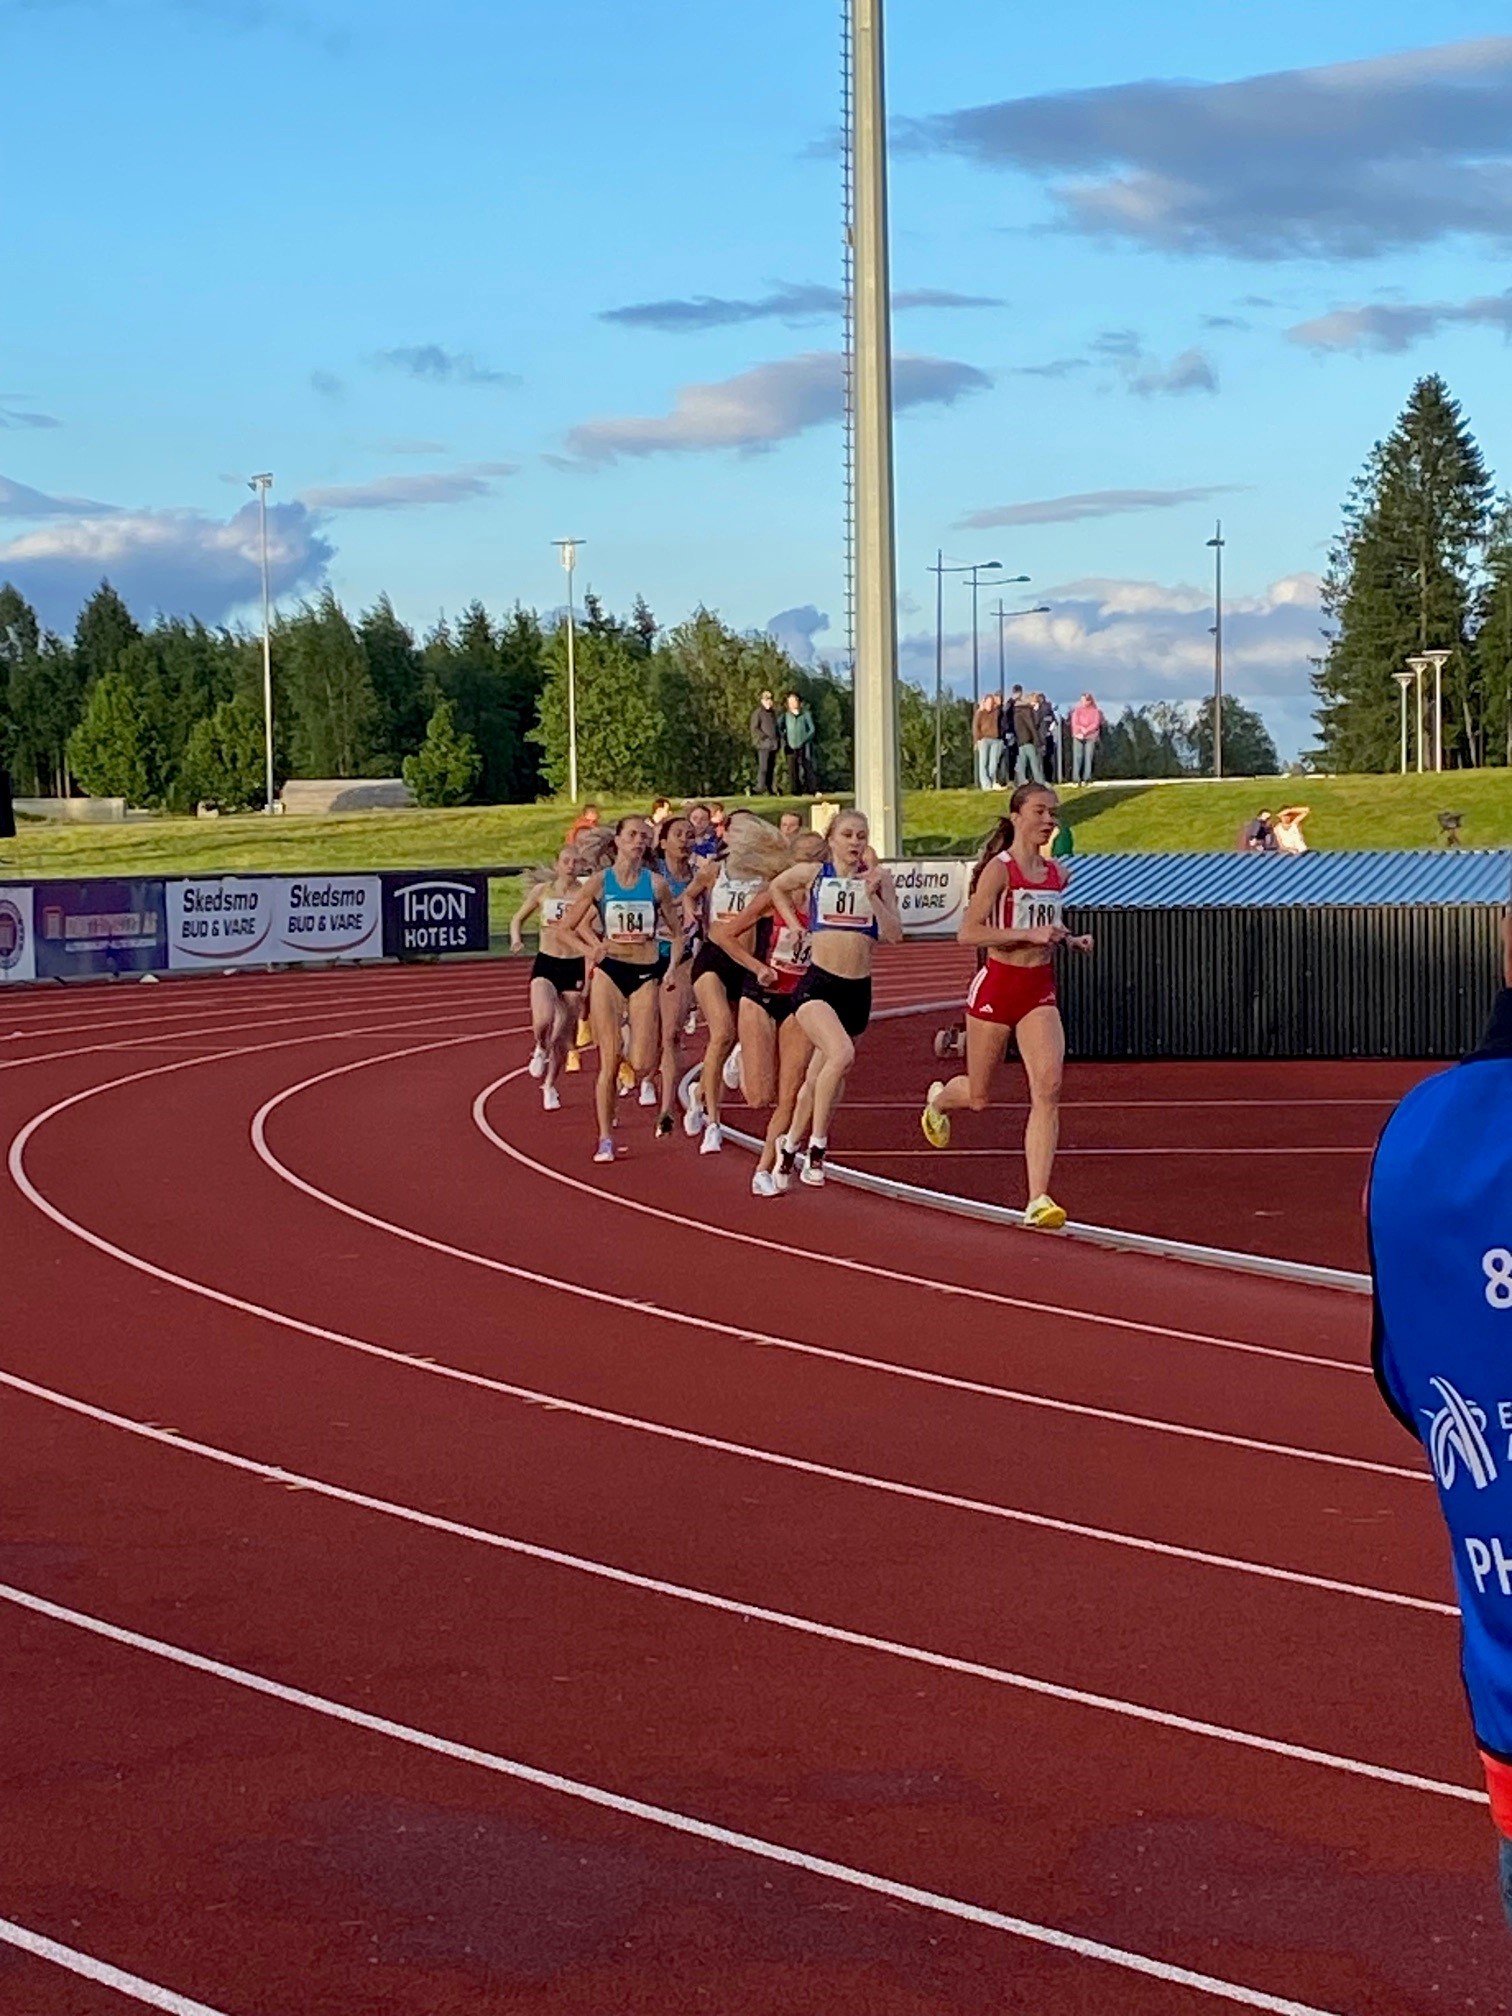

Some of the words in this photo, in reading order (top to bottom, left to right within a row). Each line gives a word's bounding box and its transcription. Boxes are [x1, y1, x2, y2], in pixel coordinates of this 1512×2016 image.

[891, 867, 949, 888] edsmo
[183, 887, 259, 913] Skedsmo
[290, 883, 366, 909] Skedsmo
[394, 881, 476, 922] THON
[835, 890, 855, 915] 81
[901, 894, 911, 910] &
[914, 893, 947, 909] VARE
[181, 920, 209, 938] BUD
[211, 919, 220, 937] &
[223, 917, 256, 936] VARE
[288, 915, 315, 933] BUD
[318, 914, 327, 932] &
[329, 913, 365, 932] VARE
[617, 912, 643, 933] 184
[404, 926, 467, 948] HOTELS
